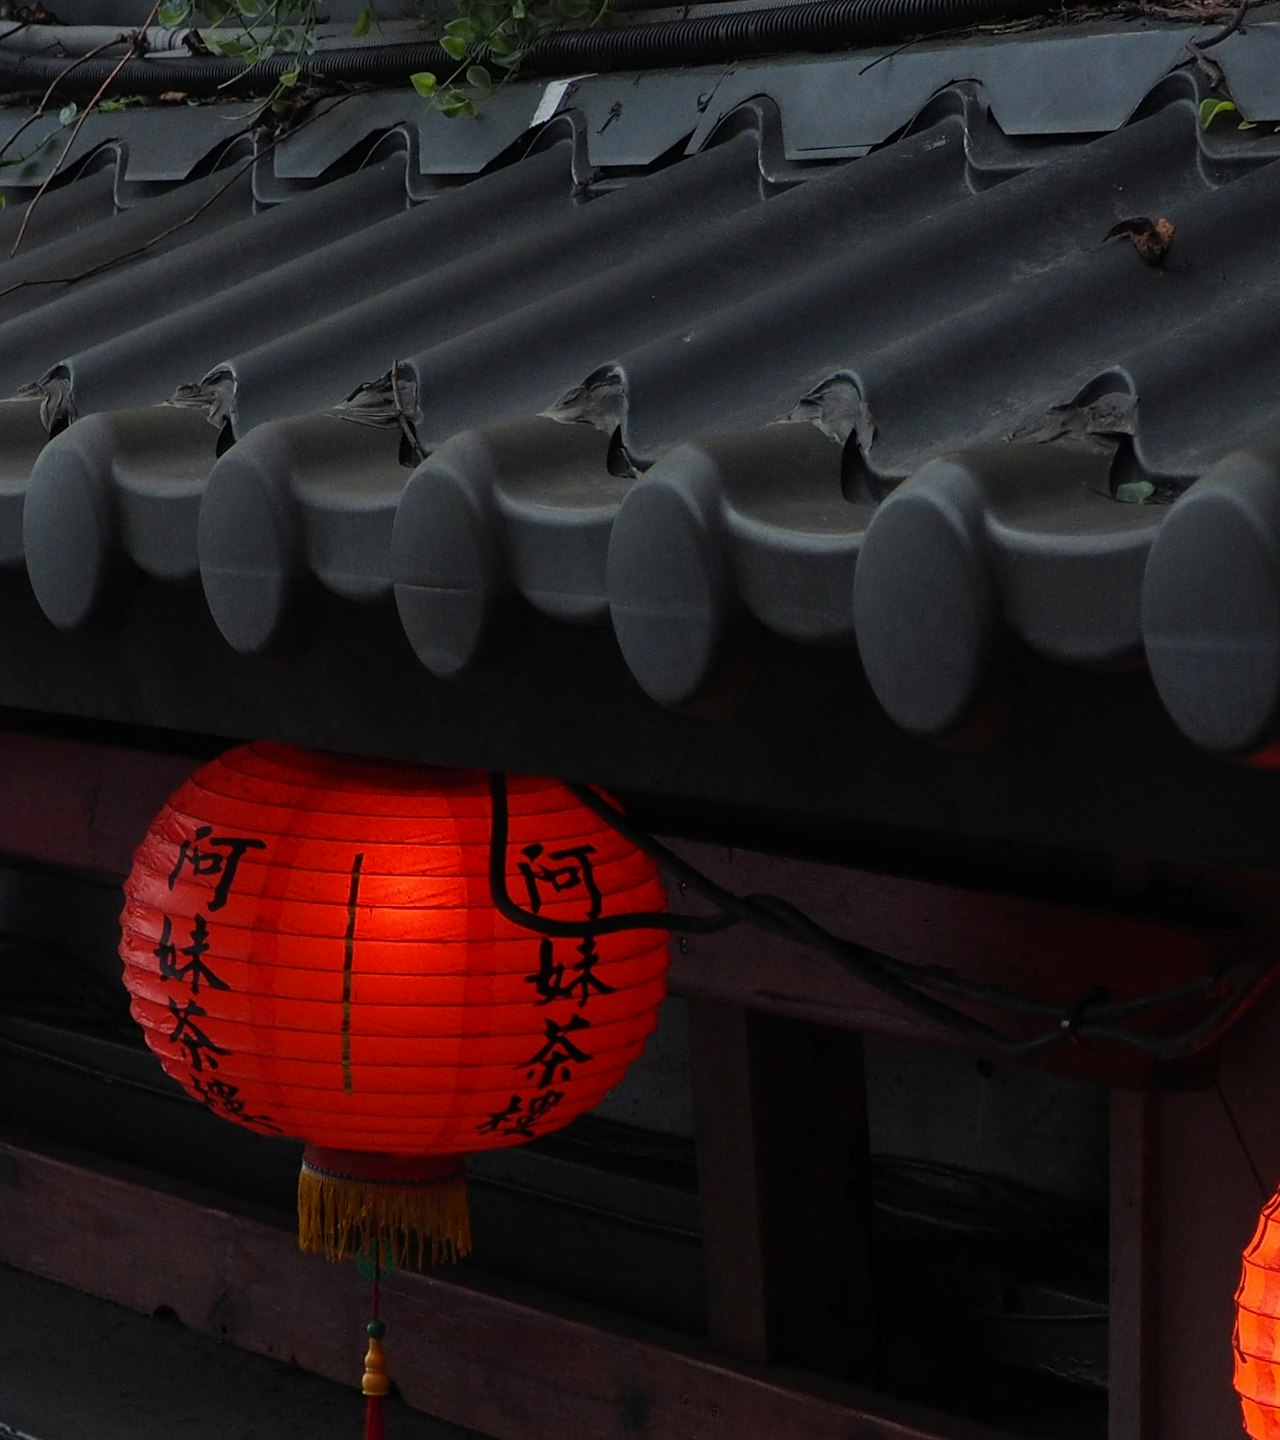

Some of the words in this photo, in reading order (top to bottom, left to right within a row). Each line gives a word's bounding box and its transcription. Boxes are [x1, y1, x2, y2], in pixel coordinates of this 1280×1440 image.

[153, 826, 284, 1133] 阿妹茶樓
[474, 843, 618, 1138] 阿妹茶樓
